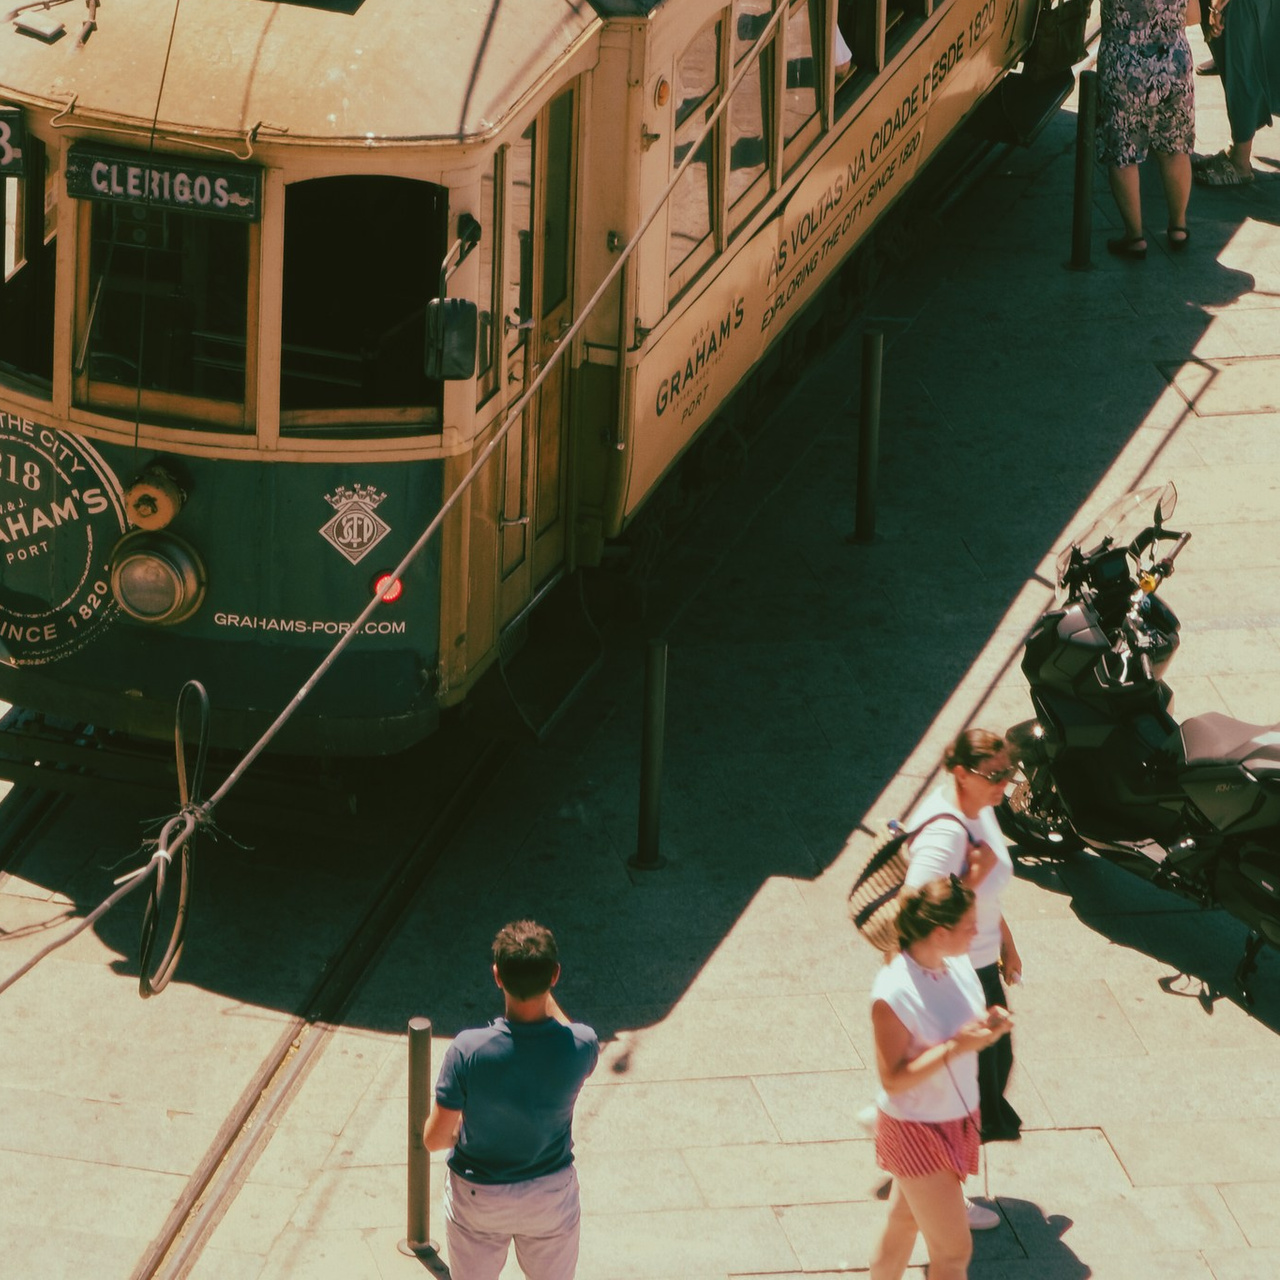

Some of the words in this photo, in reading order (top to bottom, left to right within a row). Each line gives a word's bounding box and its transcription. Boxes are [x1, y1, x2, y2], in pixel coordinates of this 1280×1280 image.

[791, 173, 844, 255] VOLTAS
[846, 148, 866, 191] NA
[870, 83, 919, 164] CIDADE
[921, 30, 965, 104] DESDE
[90, 160, 229, 209] CLERIGOS
[760, 251, 819, 333] EXPLORING
[821, 223, 842, 261] THE
[841, 195, 867, 236] CITY
[866, 158, 897, 207] SINCE
[898, 130, 921, 170] 1820
[656, 296, 745, 417] GRAHAM'S
[680, 383, 710, 425] PORT
[39, 429, 87, 475] CITY
[5, 540, 49, 565] PORT
[67, 579, 109, 630] 1820
[214, 612, 407, 635] GRAHAMS-POR.COM
